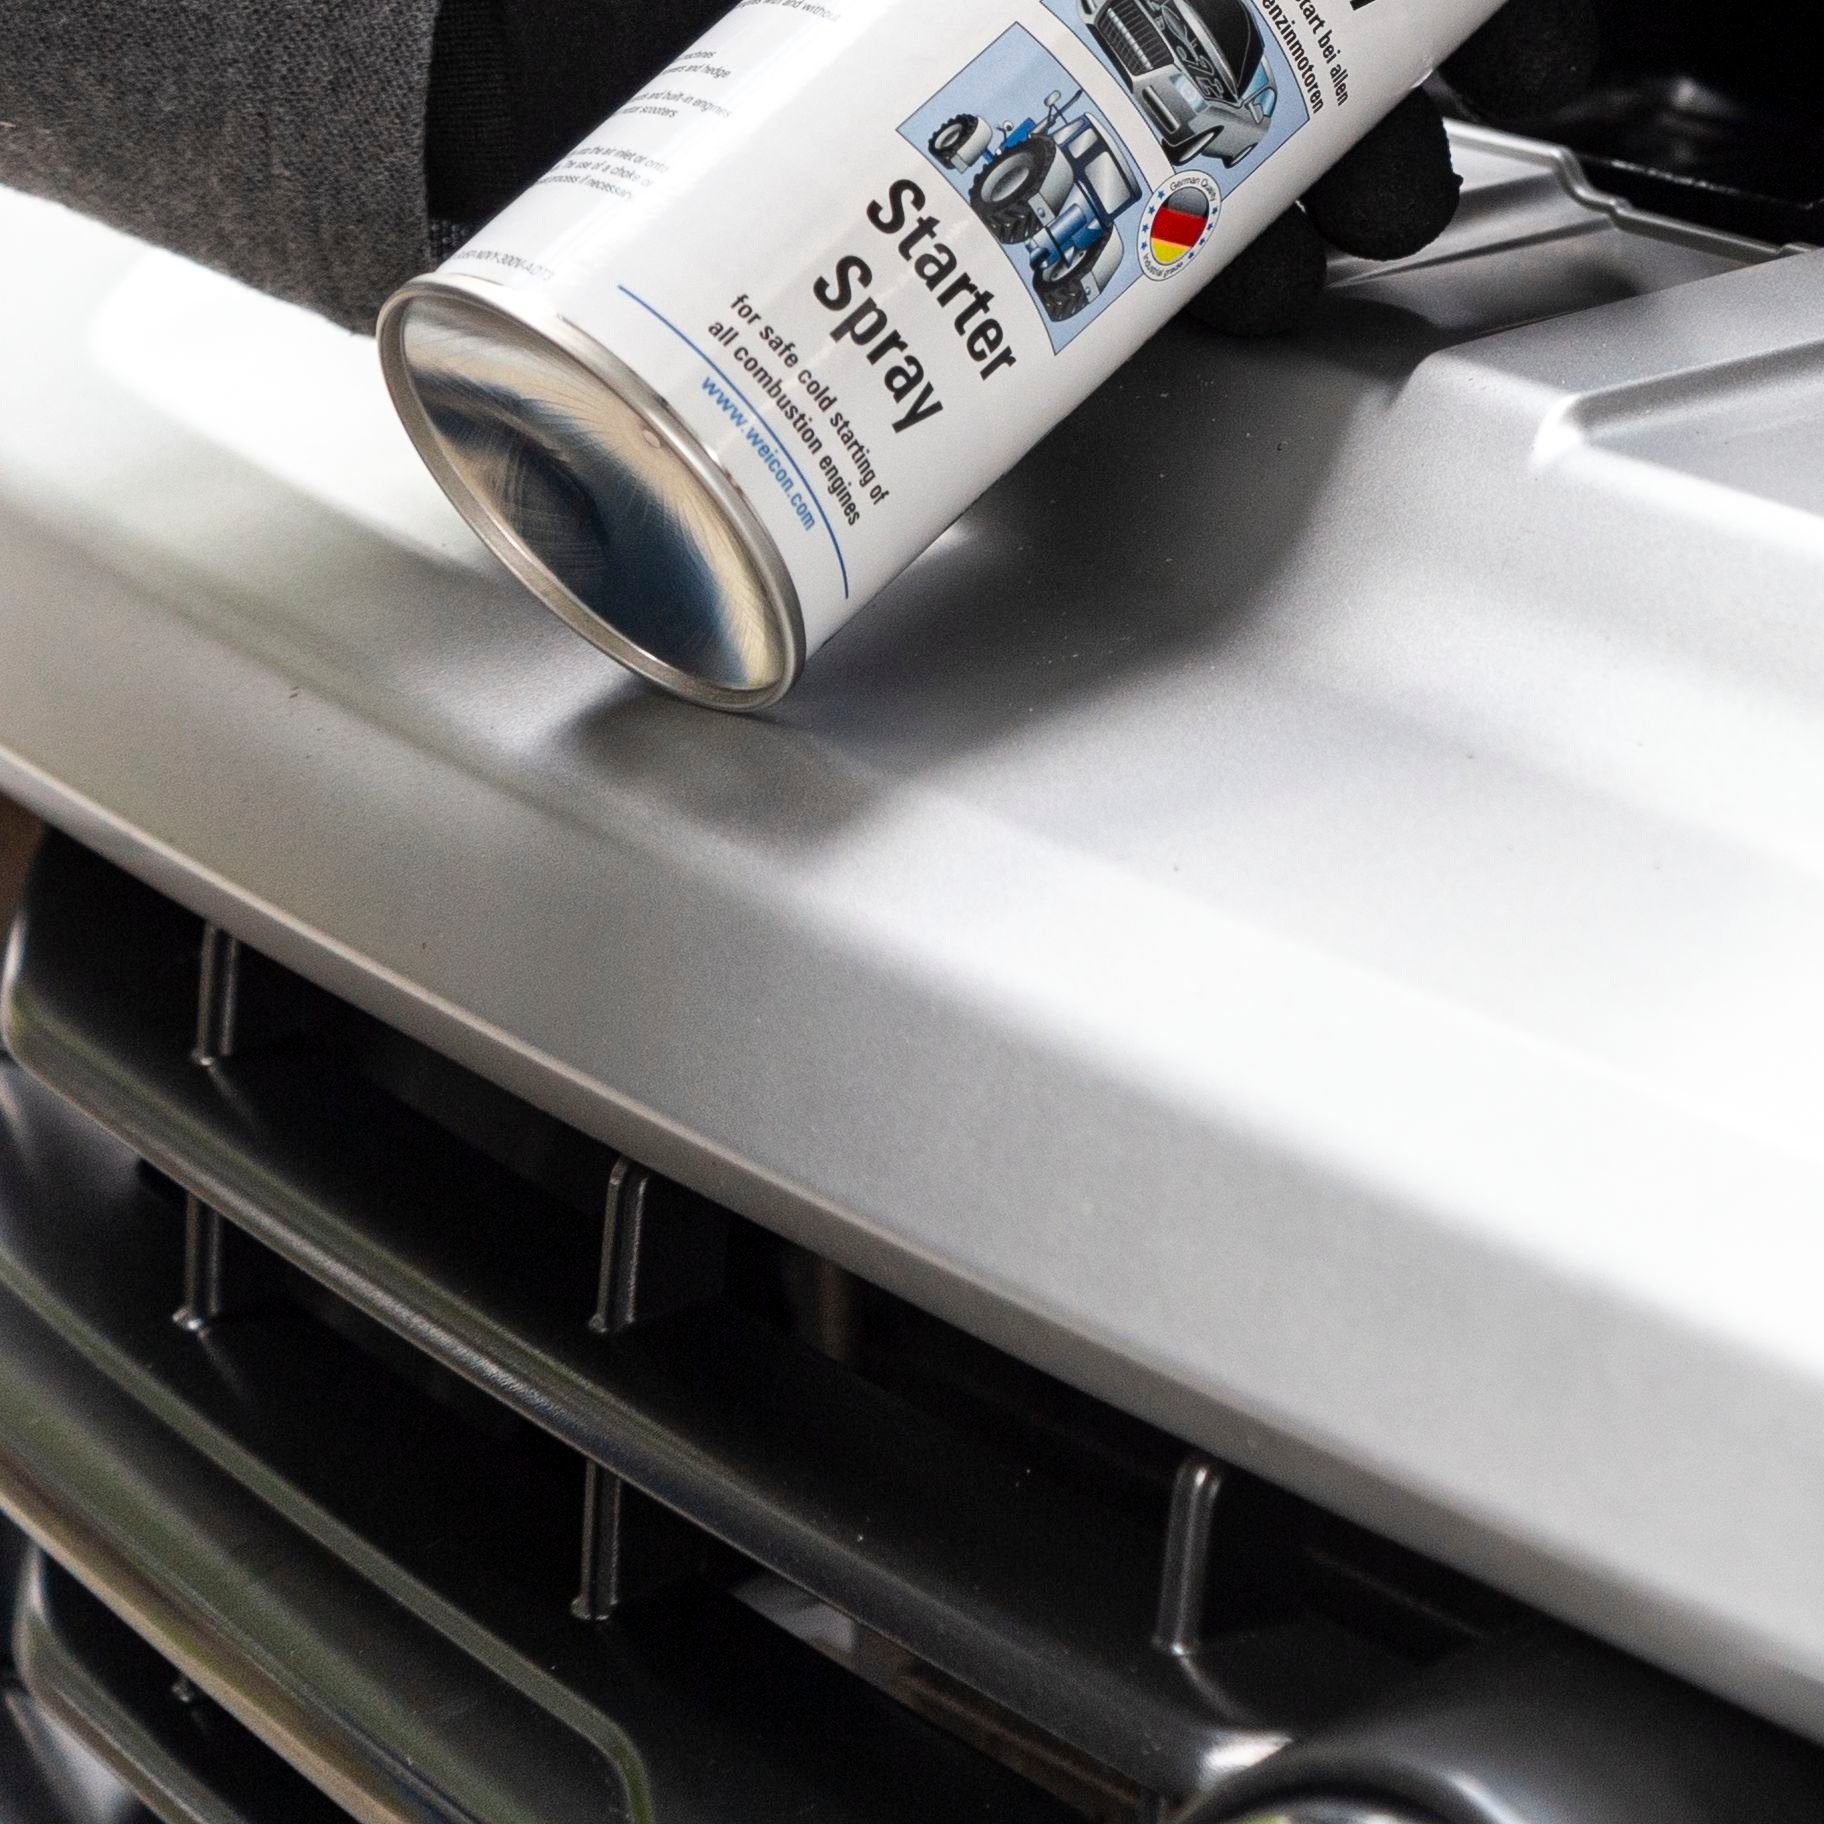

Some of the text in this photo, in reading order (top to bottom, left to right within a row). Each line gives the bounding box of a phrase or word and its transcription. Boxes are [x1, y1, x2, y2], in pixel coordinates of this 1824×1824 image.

[1317, 29, 1342, 66] bei
[1329, 63, 1350, 107] allen
[1169, 176, 1201, 191] German
[812, 255, 944, 434] Spray
[866, 178, 1017, 382] Starter
[701, 376, 816, 532] www.weicon.com
[707, 321, 861, 526] all combustion engines
[729, 293, 890, 506] for safe cold starting of
